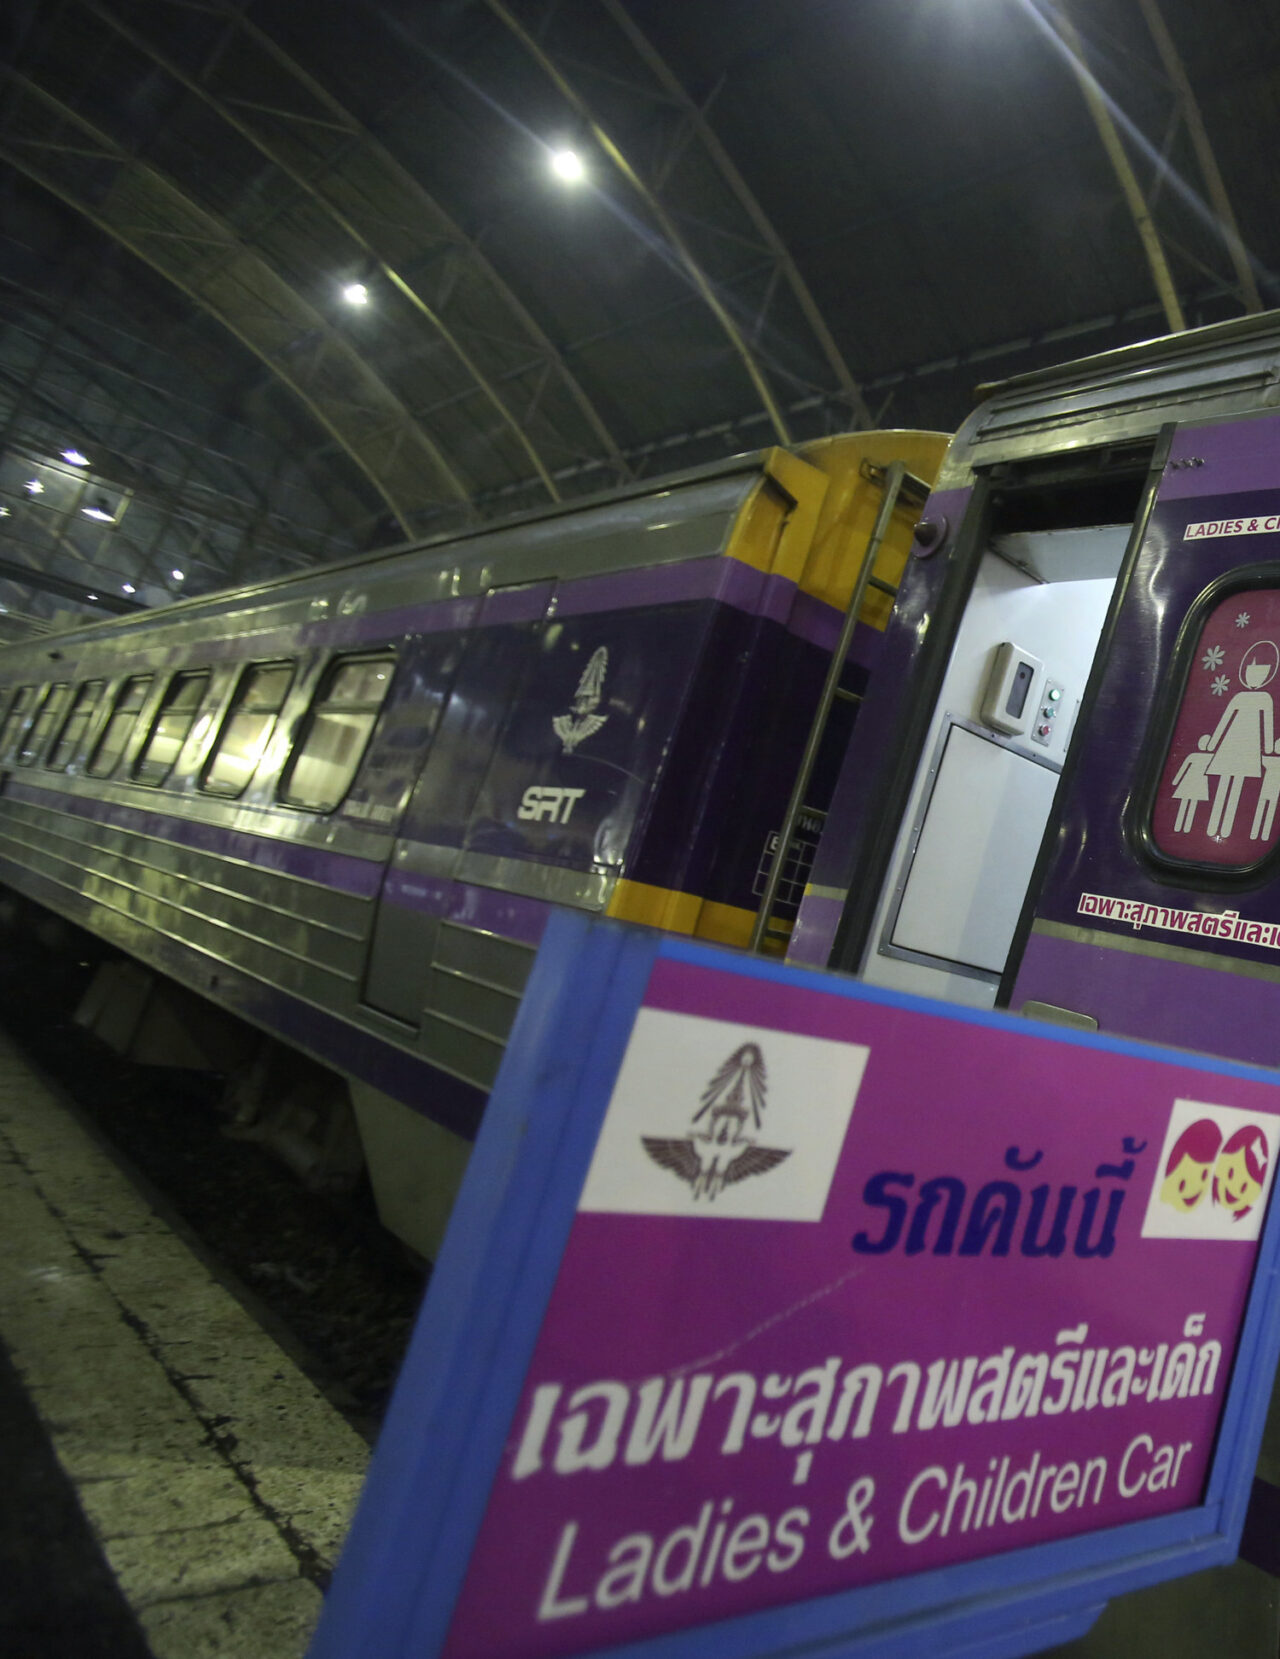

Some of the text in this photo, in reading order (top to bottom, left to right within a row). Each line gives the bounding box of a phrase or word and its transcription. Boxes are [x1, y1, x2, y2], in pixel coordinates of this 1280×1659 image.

[1185, 519, 1243, 539] LADIES
[1246, 518, 1259, 532] &
[516, 785, 587, 825] SRT
[851, 1136, 1148, 1258] รถคันนี้
[511, 1312, 1222, 1485] เฉพาะสุภาพสตรีและเด็ก
[537, 1433, 1194, 1622] Ladies & Children Car
